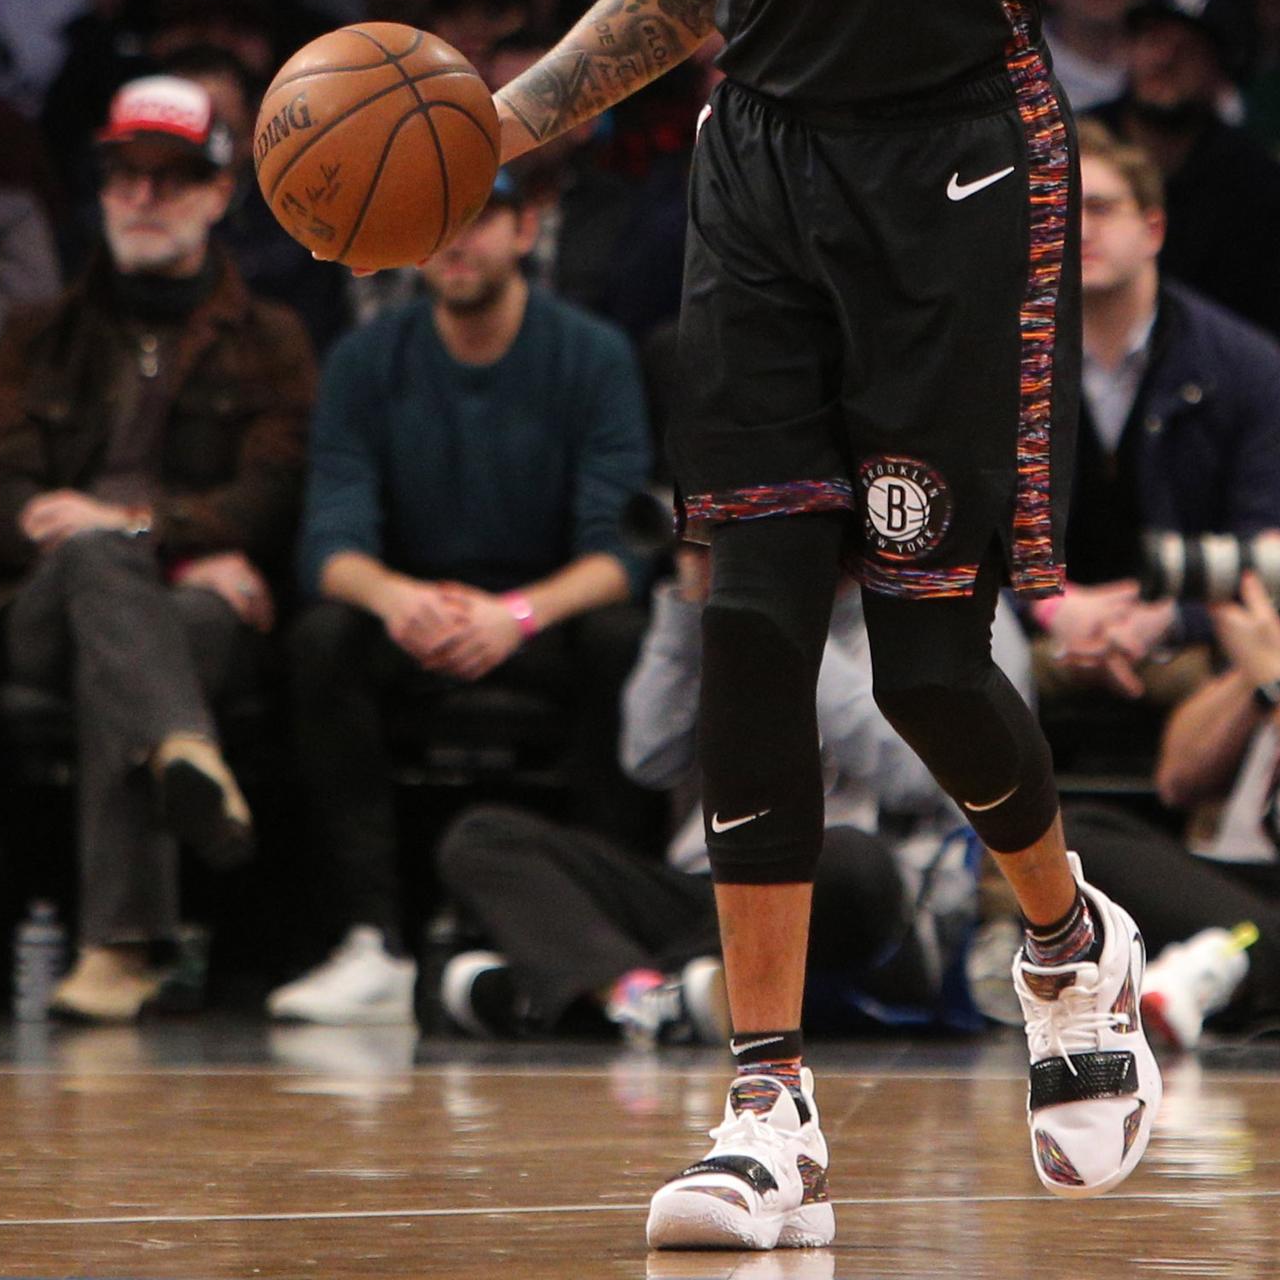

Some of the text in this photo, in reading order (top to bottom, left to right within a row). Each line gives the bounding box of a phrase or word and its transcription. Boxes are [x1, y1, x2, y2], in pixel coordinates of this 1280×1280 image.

[862, 464, 940, 499] BROOKLYN
[887, 484, 907, 532] B
[896, 529, 935, 554] YORK
